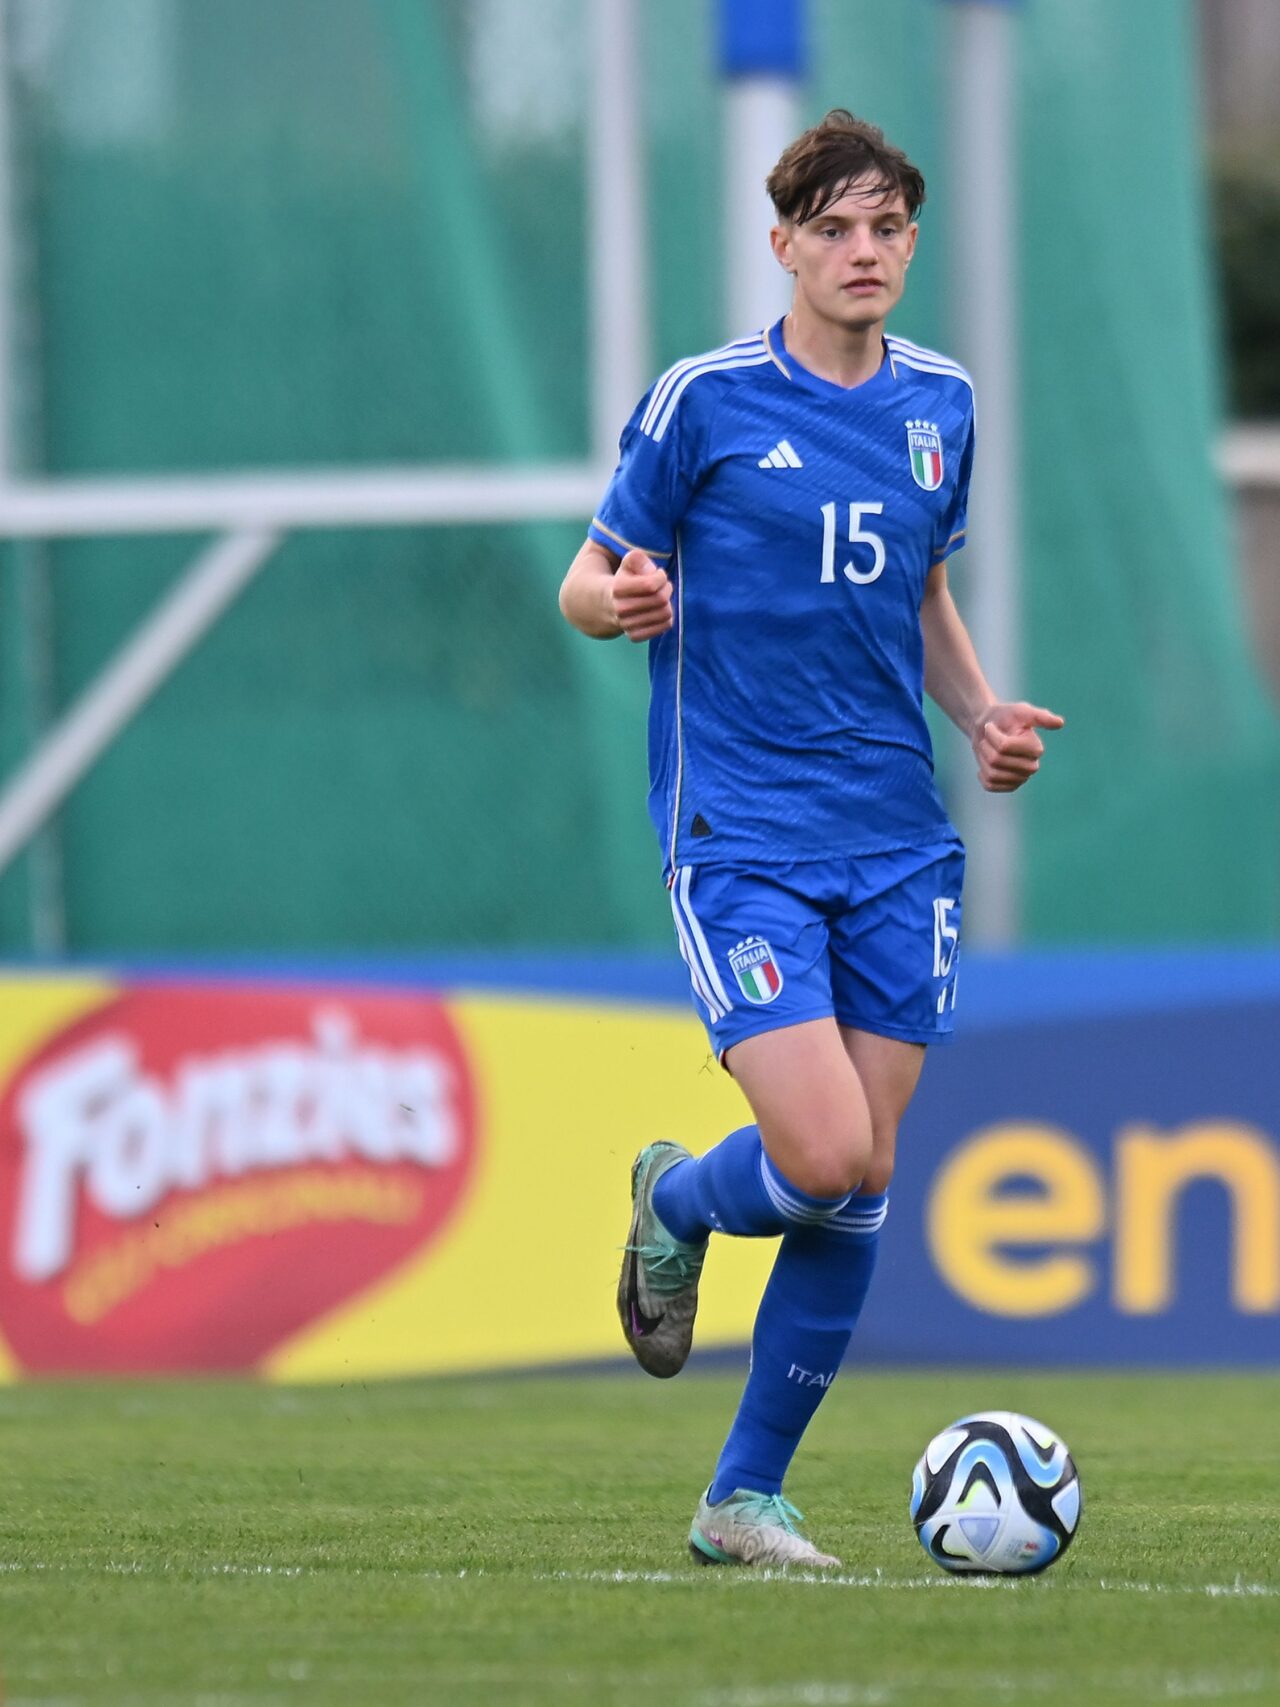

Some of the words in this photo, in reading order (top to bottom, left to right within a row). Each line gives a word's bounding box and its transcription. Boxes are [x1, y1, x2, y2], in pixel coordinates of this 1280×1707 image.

[910, 433, 938, 449] ITALIA
[820, 501, 886, 585] 15
[733, 946, 770, 971] ITALIA
[933, 898, 957, 977] 15
[13, 1008, 460, 1283] Fonzies
